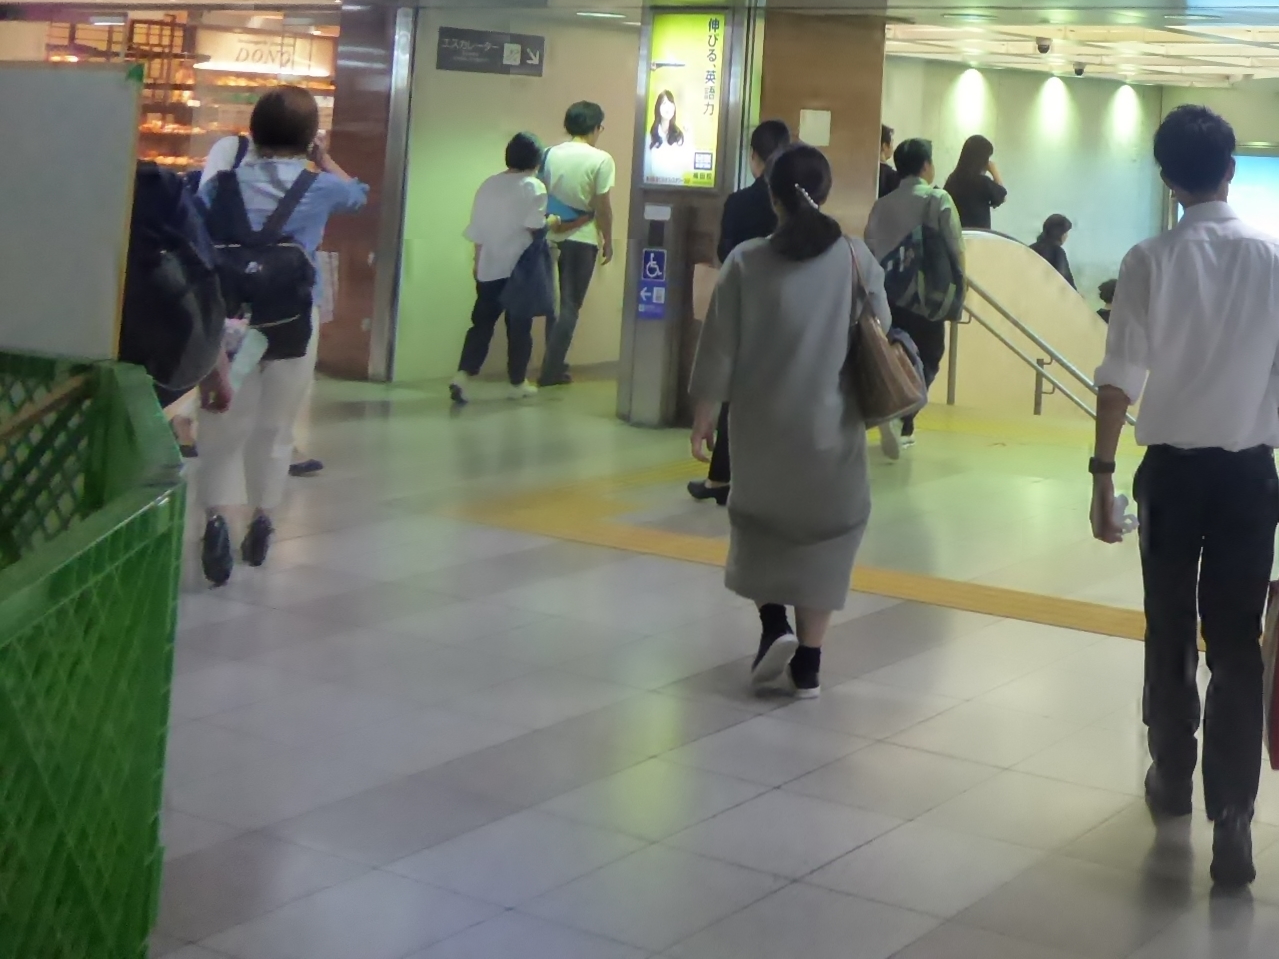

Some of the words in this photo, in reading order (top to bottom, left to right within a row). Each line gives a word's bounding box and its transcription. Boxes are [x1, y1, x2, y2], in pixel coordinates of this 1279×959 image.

[441, 37, 500, 53] エスカレーター
[703, 16, 720, 117] 伸びる、英語力
